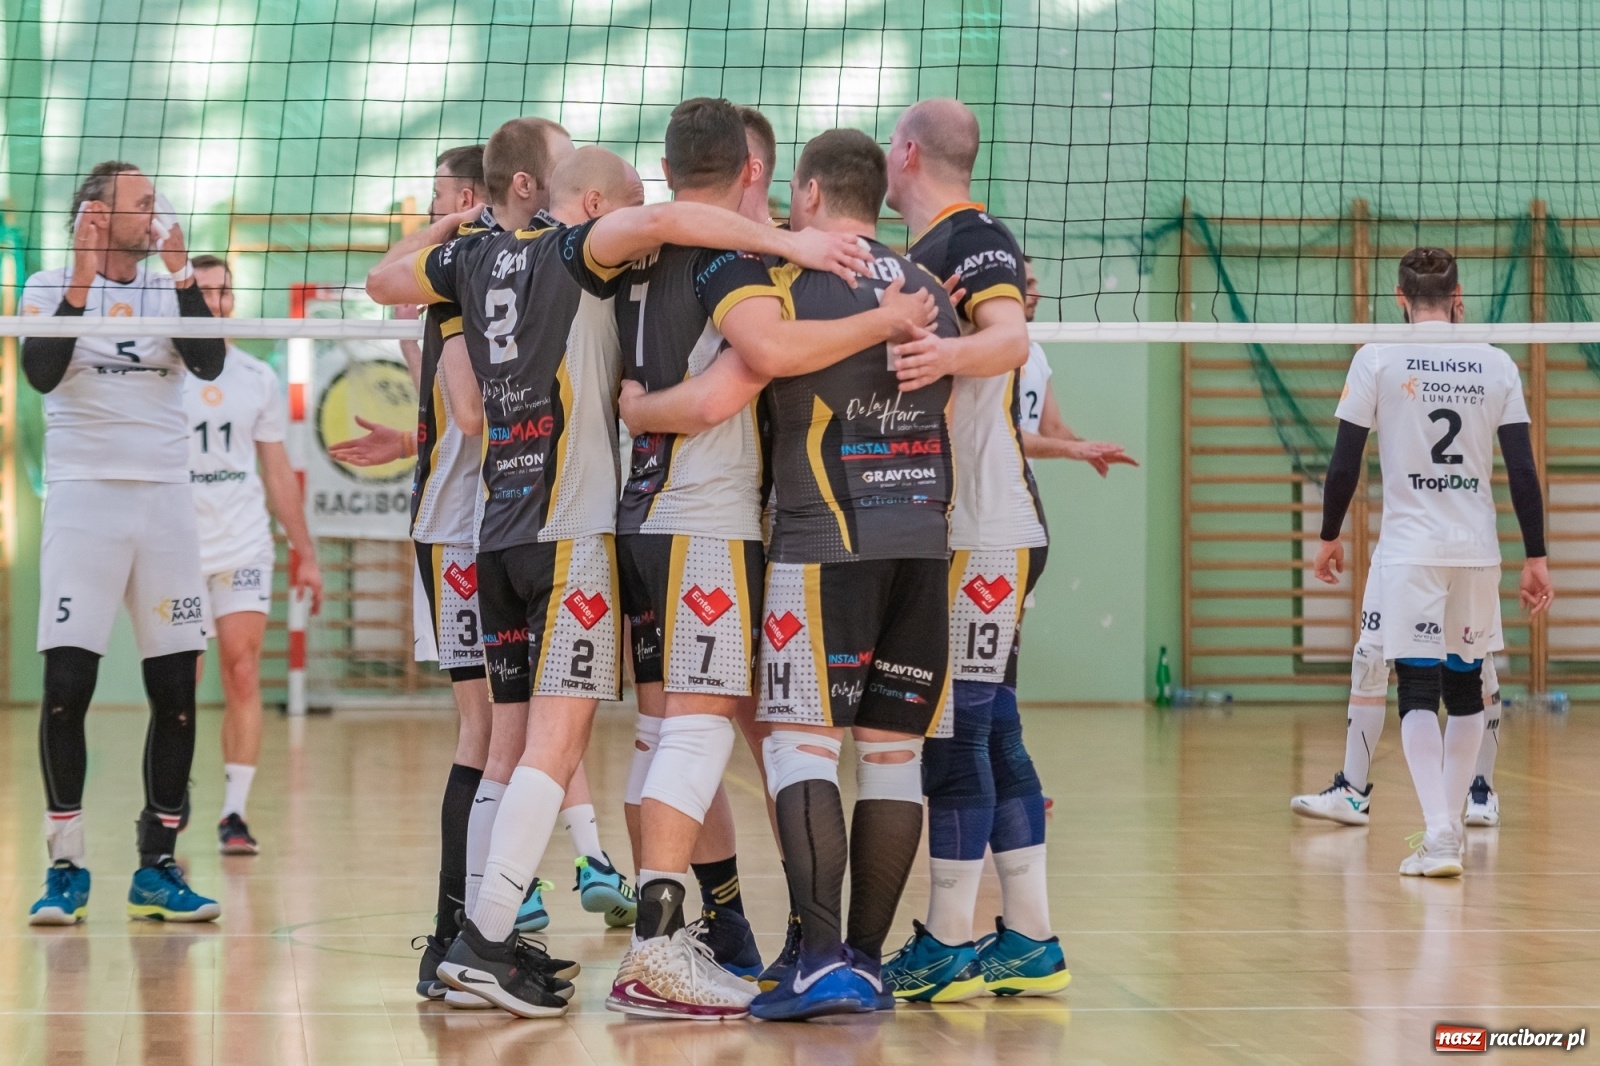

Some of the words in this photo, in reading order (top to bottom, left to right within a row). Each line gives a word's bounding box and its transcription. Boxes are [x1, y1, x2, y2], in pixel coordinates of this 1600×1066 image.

[484, 288, 518, 364] 2
[116, 341, 141, 363] 5
[1406, 358, 1482, 374] ZIELIŃSKI
[878, 390, 926, 435] Hair
[1422, 394, 1485, 405] LUNATYCY
[193, 421, 232, 453] 11
[841, 439, 942, 459] INSTALMAG
[1427, 408, 1463, 465] 2
[861, 467, 937, 483] GRAVTON
[1408, 473, 1480, 494] TropiDog
[450, 566, 473, 591] Enter
[171, 596, 202, 611] ZOO
[691, 590, 716, 616] Enter
[973, 580, 996, 604] Enter
[56, 597, 72, 623] 5
[573, 594, 595, 620] Enter
[456, 609, 479, 647] 3
[767, 617, 785, 641] Enter
[966, 622, 1000, 660] 13
[570, 638, 595, 679] 2
[697, 635, 716, 674] 7
[767, 662, 791, 701] 14
[874, 660, 934, 682] GRAVTON
